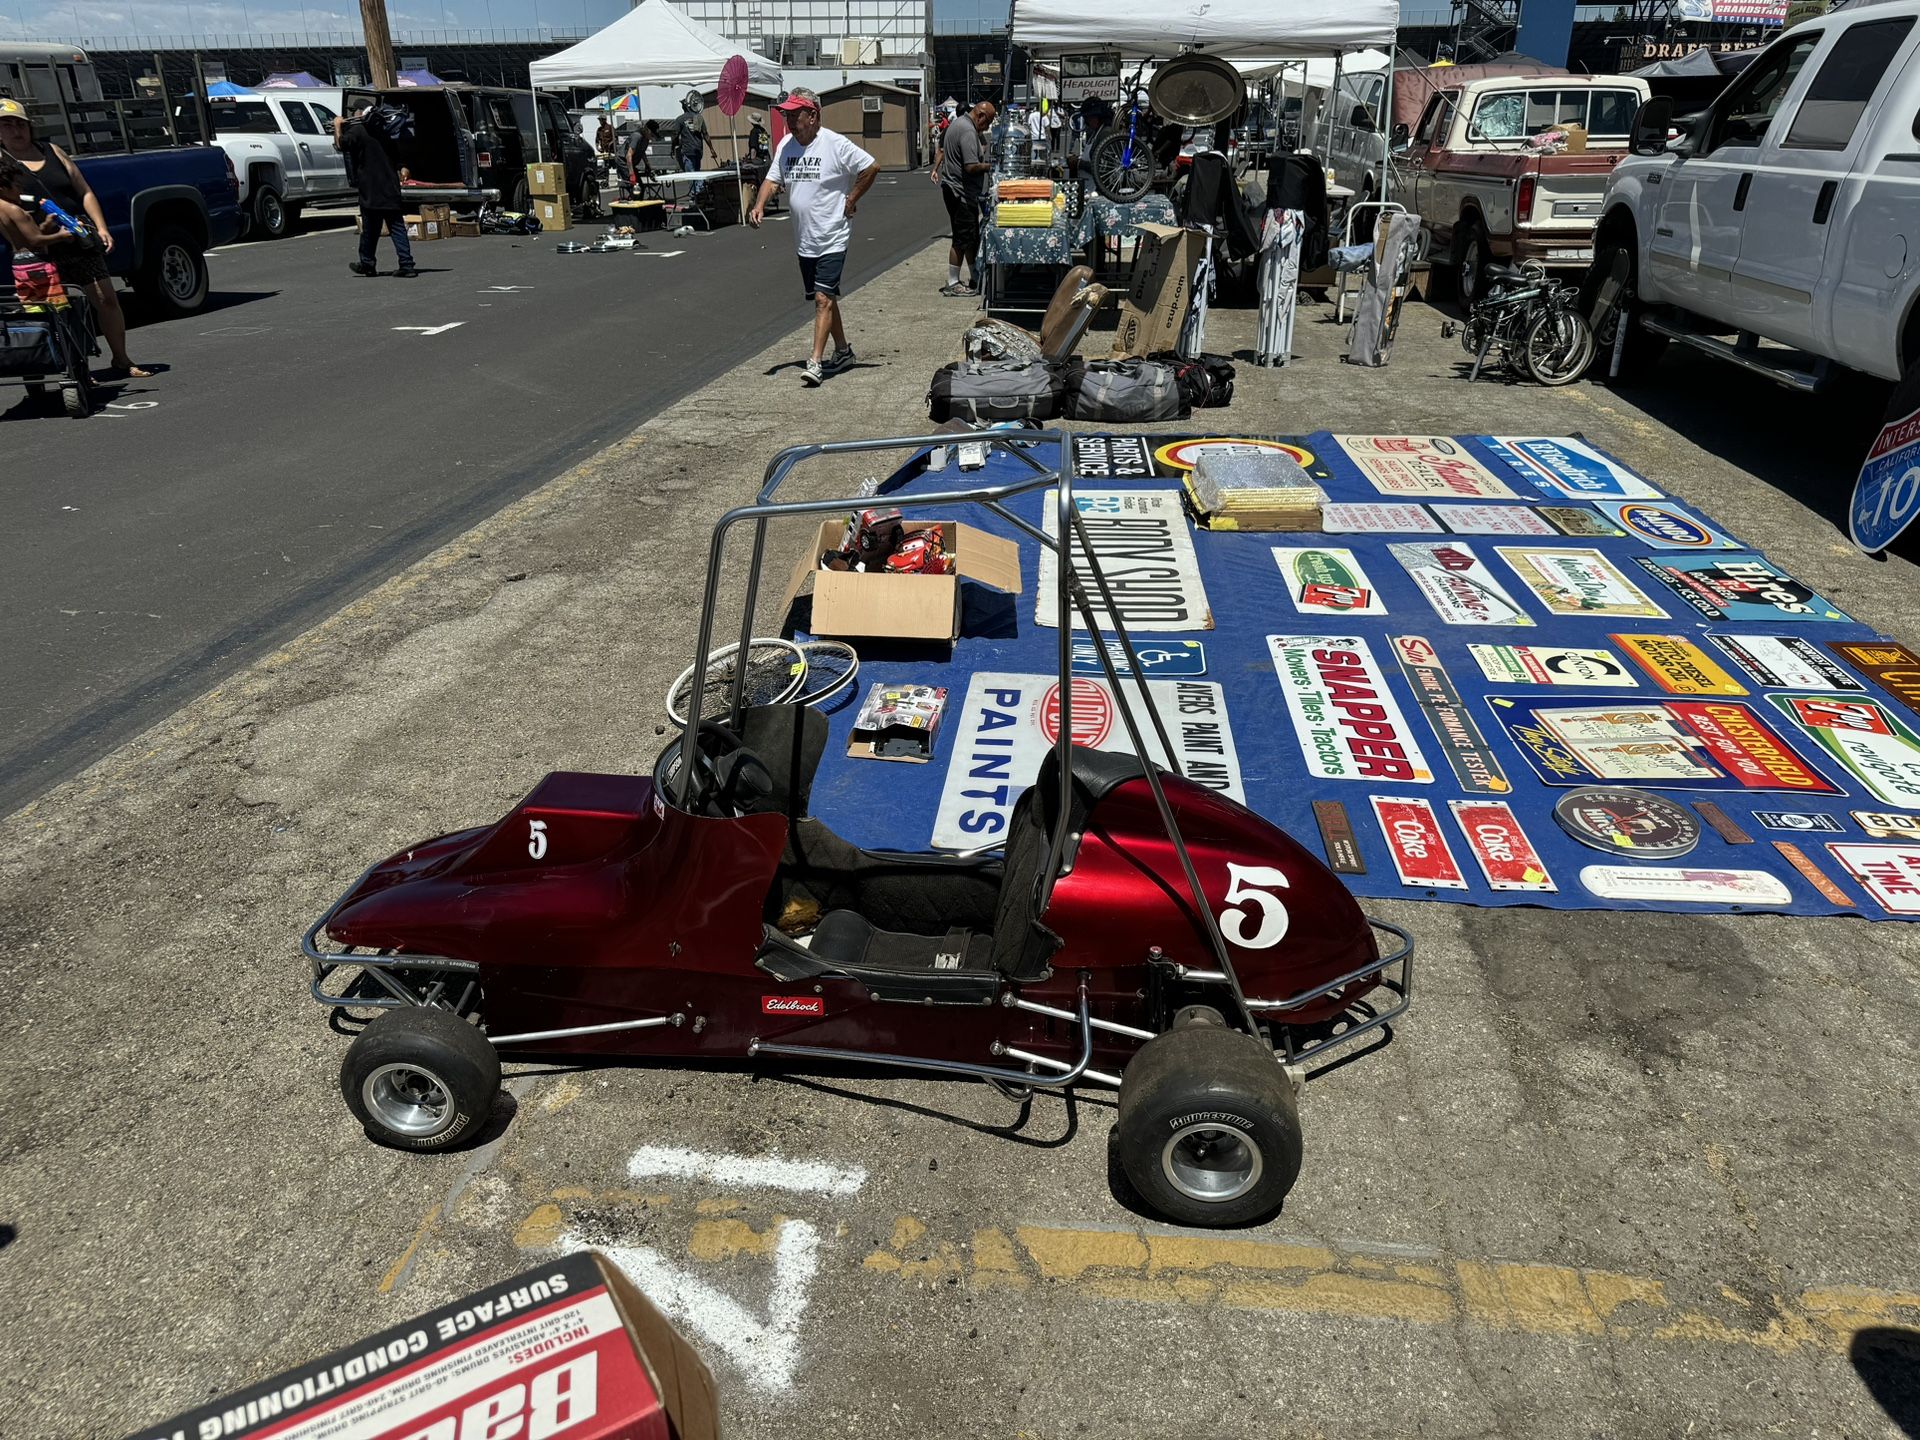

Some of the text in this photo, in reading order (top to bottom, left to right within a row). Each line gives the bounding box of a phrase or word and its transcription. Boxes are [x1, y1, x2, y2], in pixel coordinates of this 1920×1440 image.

[1716, 5, 1787, 16] GRANDSTAND
[1717, 16, 1764, 24] SECTIONS
[1064, 79, 1117, 88] HEADLIGHT
[1082, 88, 1117, 98] POLISH
[1161, 275, 1189, 329] ezup.com
[1077, 437, 1108, 475] SERVICE
[1110, 438, 1144, 475] PARTS &
[1383, 460, 1404, 471] SALES
[1394, 473, 1419, 486] PARTS
[1493, 445, 1552, 487] TIRES
[1408, 461, 1445, 488] DEALER
[1418, 456, 1484, 496] Indian
[1872, 466, 1920, 527] 10
[1071, 518, 1177, 563] BODY
[1633, 509, 1701, 541] RAINBO
[1071, 566, 1189, 622] SHOP
[1430, 576, 1463, 607] CHAMPIONS
[1474, 590, 1489, 600] THE
[1548, 557, 1590, 582] Mountain
[1574, 582, 1608, 598] Dew
[1687, 571, 1742, 599] ROOT BEER
[1712, 561, 1815, 614] Hires
[1675, 588, 1700, 598] ICE
[1688, 600, 1724, 616] COLD
[1073, 644, 1096, 663] ONLY
[1400, 638, 1433, 663] Sun
[1563, 651, 1598, 681] CLINTON
[1635, 640, 1668, 666] MOTOR
[1663, 667, 1687, 680] OIL
[1650, 640, 1687, 660] AUTO
[1674, 661, 1718, 688] DIESEL
[1790, 641, 1828, 667] SHORTEST
[1822, 666, 1854, 686] ROUTE
[1282, 648, 1308, 686] Mowers
[1310, 728, 1345, 776] Tractors
[1312, 649, 1416, 780] SNAPPER
[1416, 668, 1440, 690] ENGINE
[1428, 694, 1473, 747] PEFORMANCE
[1804, 703, 1874, 730] 7up
[1174, 682, 1230, 792] AYERS PAINT AND
[1513, 724, 1557, 746] They
[1687, 714, 1766, 776] BEST FOR YOU
[1704, 706, 1814, 786] CHESTERFIELD
[958, 688, 1021, 834] PAINTS
[1841, 740, 1920, 794] ravigote
[528, 820, 548, 860] 5
[1393, 820, 1428, 859] Coke
[1476, 824, 1514, 862] Coke
[1861, 860, 1920, 895] TIME
[1219, 862, 1290, 950] 5
[450, 961, 476, 969] GOODYEAR
[766, 998, 820, 1013] Edelbrock
[1170, 1111, 1256, 1131] BRIDGESTONE
[538, 1308, 581, 1331] 120-GRIT
[194, 1271, 569, 1440] SURFACE CONDITIONING
[473, 1325, 539, 1358] INTERLEAVED
[491, 1332, 547, 1360] ABRASIVES
[506, 1323, 591, 1367] INCLUDES:
[421, 1354, 474, 1382] FINISHING
[407, 1375, 449, 1398] 40-GRIT
[338, 1393, 387, 1420] 240-GRIT
[350, 1394, 407, 1424] STRIPPING
